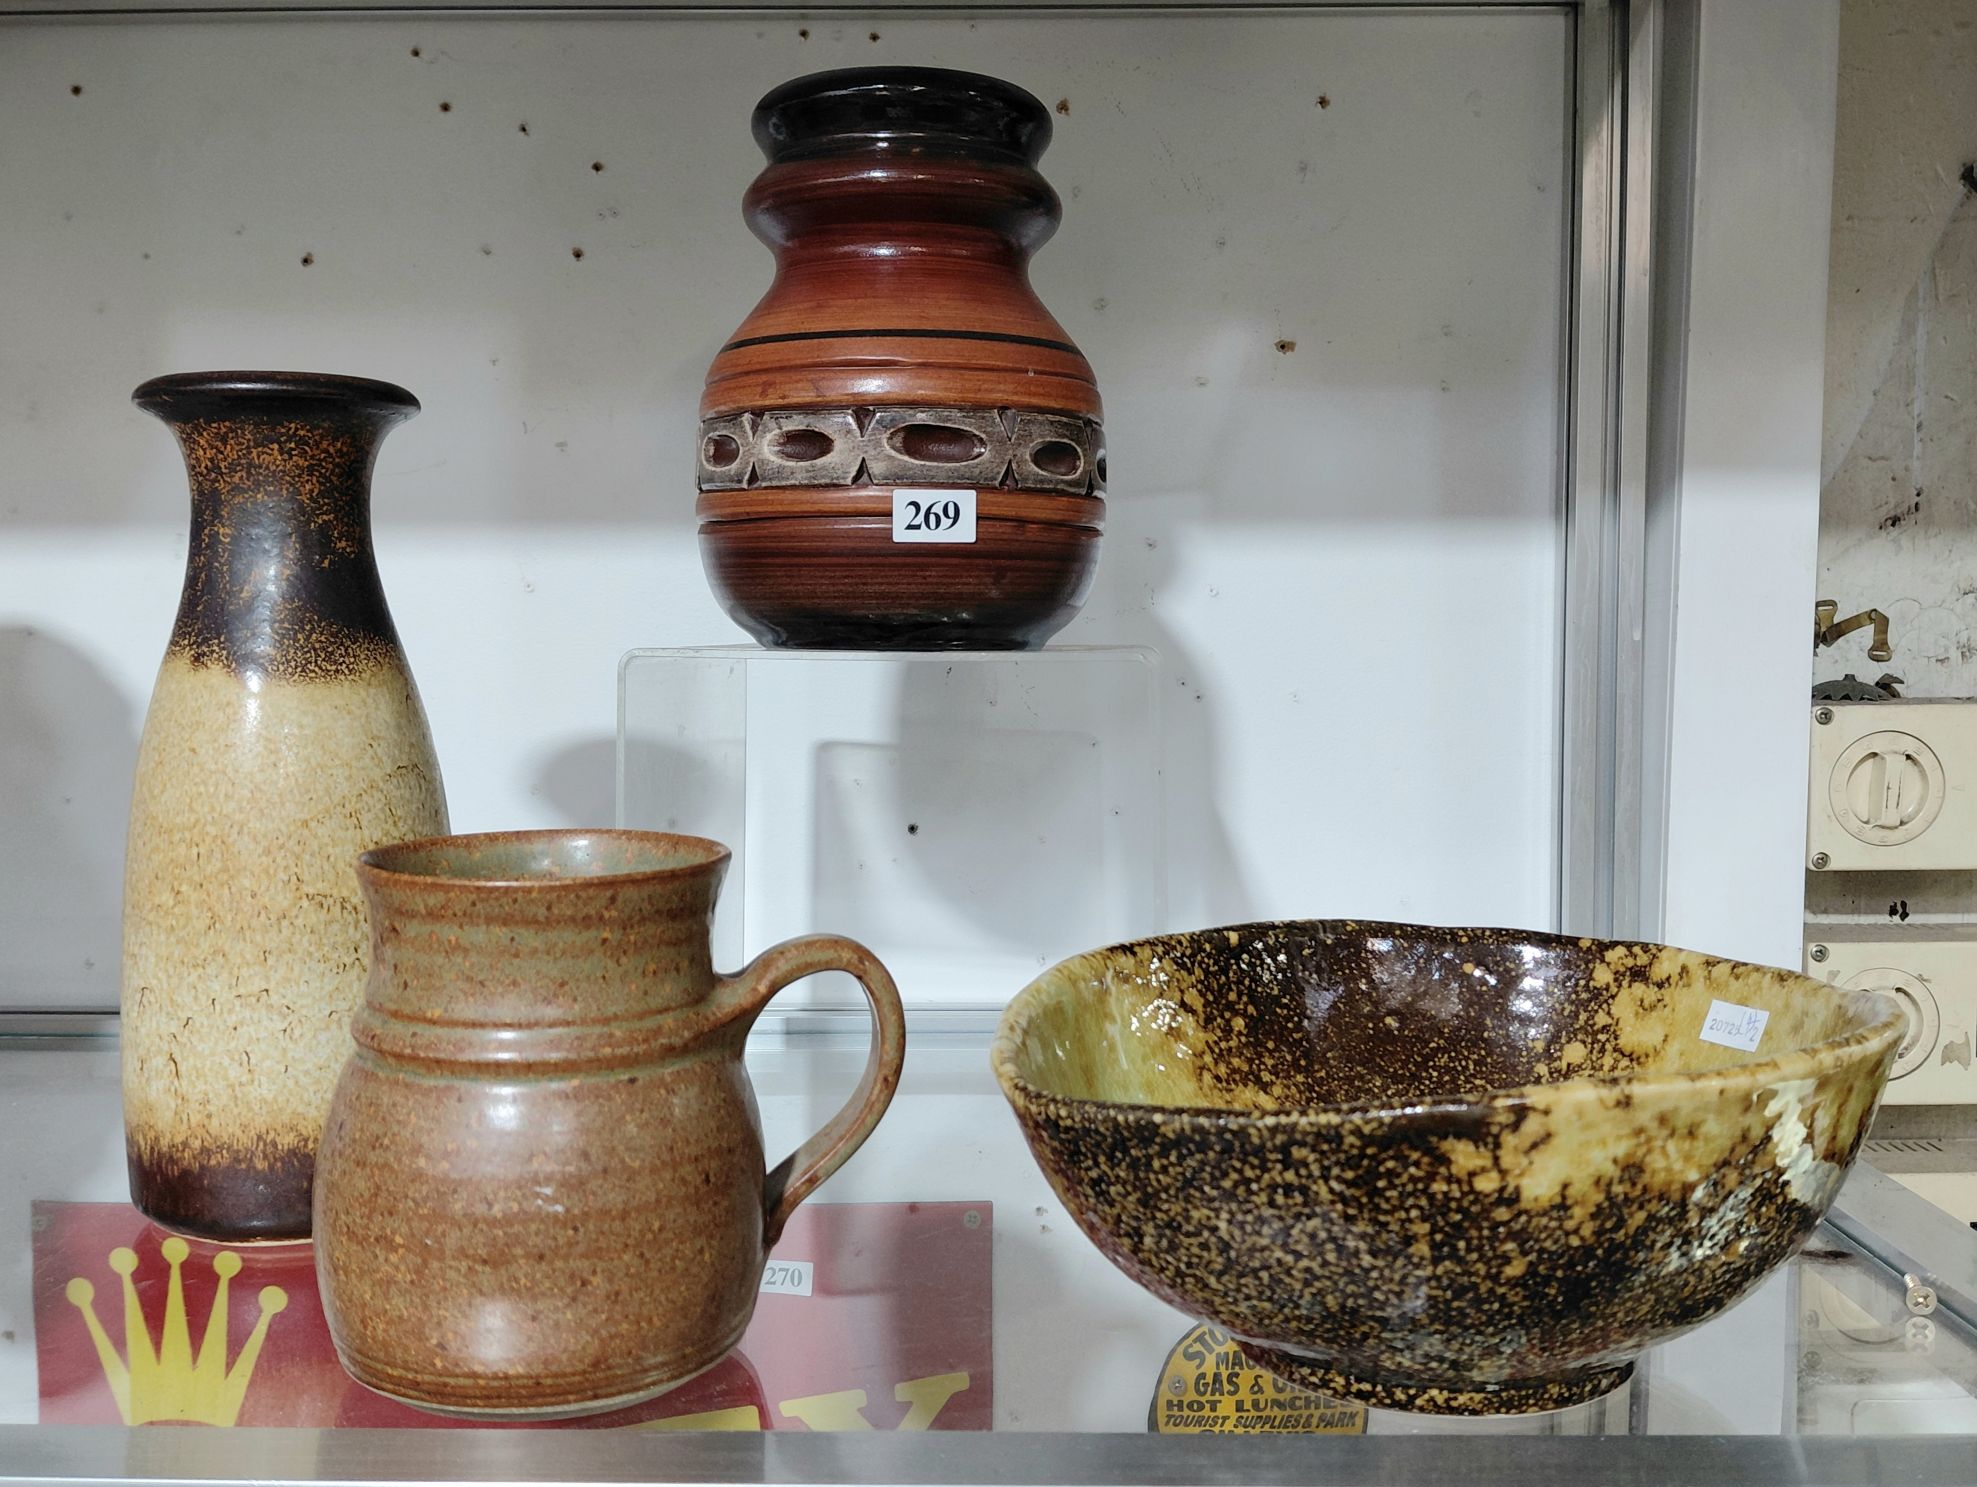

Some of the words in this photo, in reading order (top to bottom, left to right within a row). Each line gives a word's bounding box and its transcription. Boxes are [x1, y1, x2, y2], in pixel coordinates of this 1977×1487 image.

[904, 500, 961, 531] 269
[764, 1266, 803, 1288] 270
[1194, 1371, 1241, 1397] GAS
[1249, 1374, 1265, 1395] &
[1166, 1399, 1222, 1413] HOT
[1164, 1413, 1231, 1429] TOURIST
[1315, 1409, 1360, 1429] PARK
